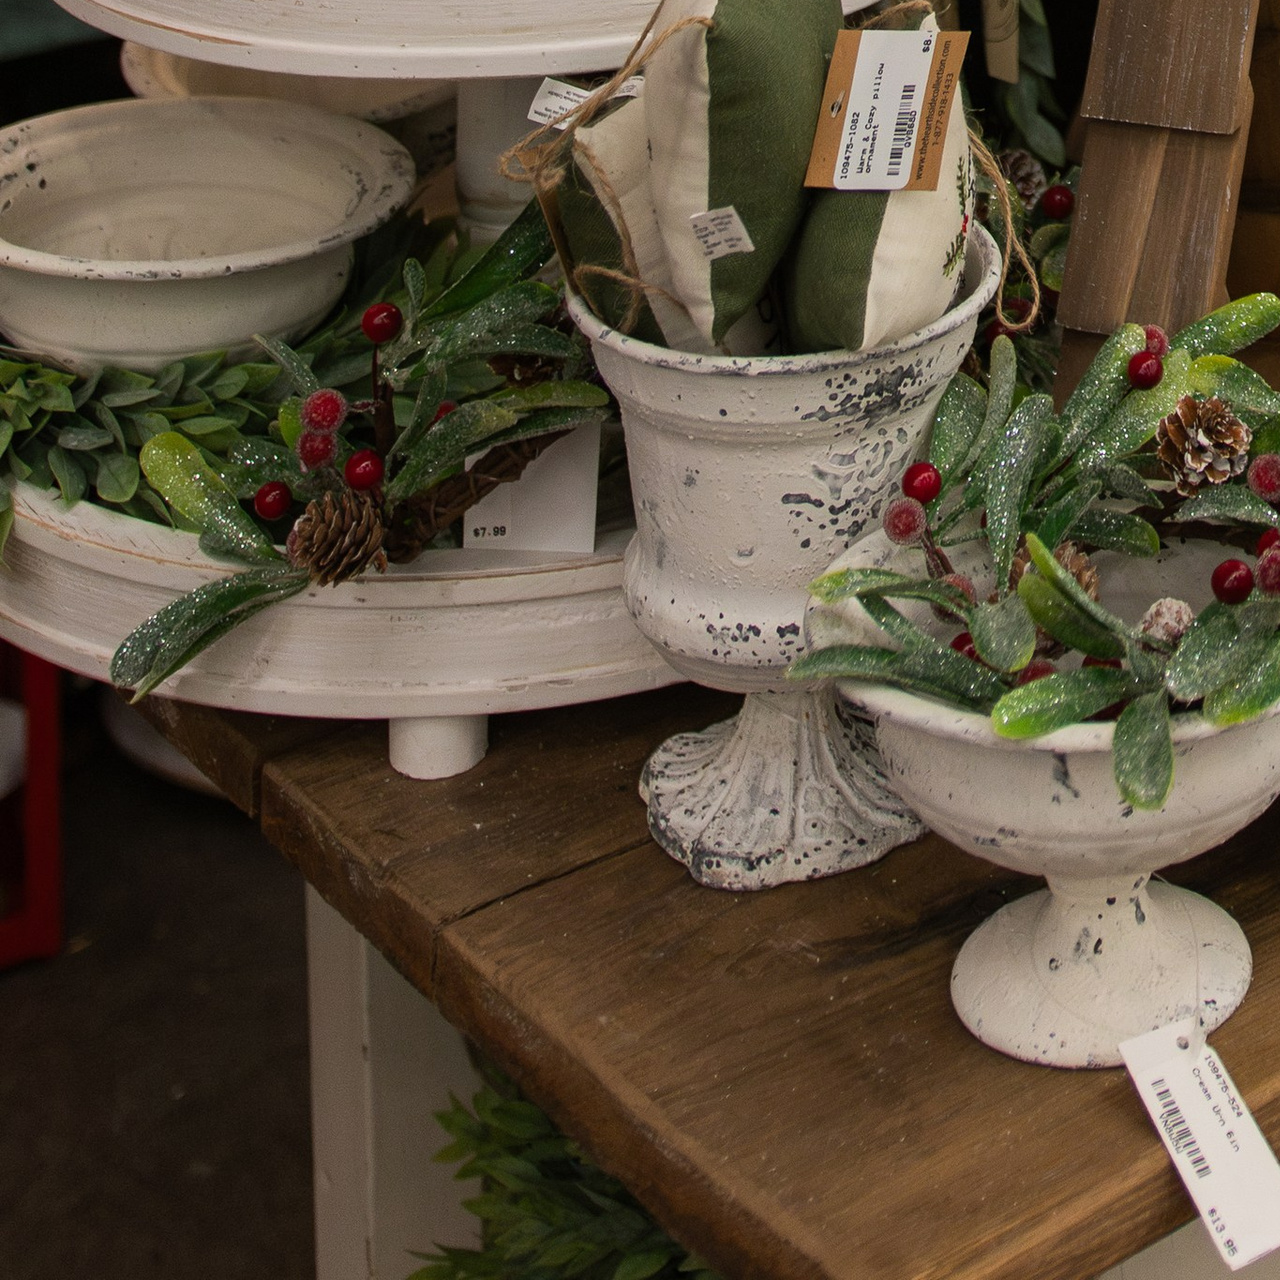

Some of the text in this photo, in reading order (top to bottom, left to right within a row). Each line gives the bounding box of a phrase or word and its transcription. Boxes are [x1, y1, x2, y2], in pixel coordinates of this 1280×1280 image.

[922, 30, 934, 53] $8.
[856, 148, 867, 174] Warm
[865, 105, 877, 130] Cozy
[873, 63, 885, 100] pillow
[932, 73, 954, 147] 1-877-918-1433
[840, 111, 860, 180] 109475-1082
[865, 124, 879, 174] ornament
[472, 525, 507, 538] $7.99
[1192, 1067, 1240, 1153] Cream Urn 6in
[1204, 1055, 1243, 1119] 109475-524
[1208, 1207, 1239, 1257] $13.95
